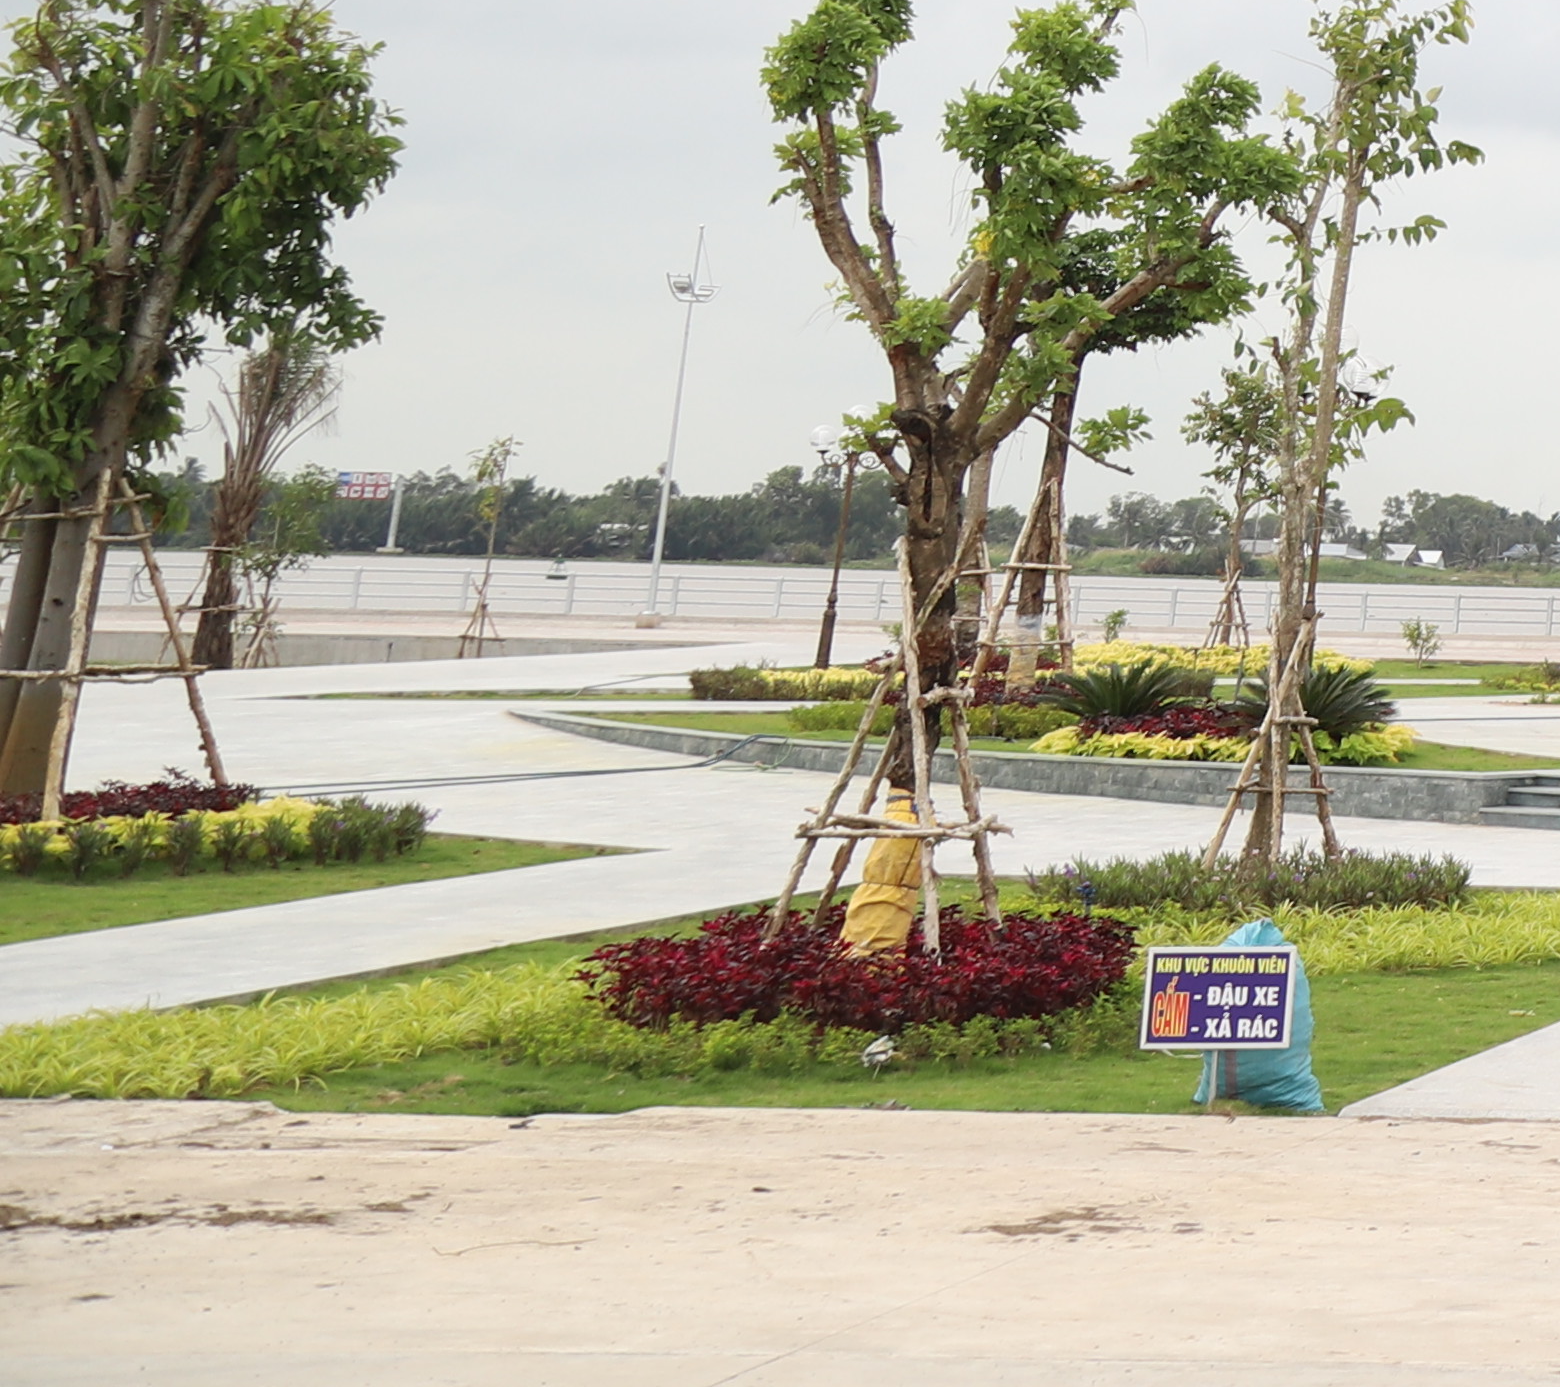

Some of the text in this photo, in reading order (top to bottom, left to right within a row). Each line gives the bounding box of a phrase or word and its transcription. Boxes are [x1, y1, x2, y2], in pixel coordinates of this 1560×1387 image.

[1156, 955, 1287, 977] KHU VỰC KHUÔN VIÊN
[1152, 976, 1190, 1037] CẤM
[1207, 982, 1248, 1010] ĐẬU
[1252, 986, 1279, 1006] XE
[1204, 1011, 1232, 1038] XẢ
[1236, 1014, 1279, 1038] RÁC
